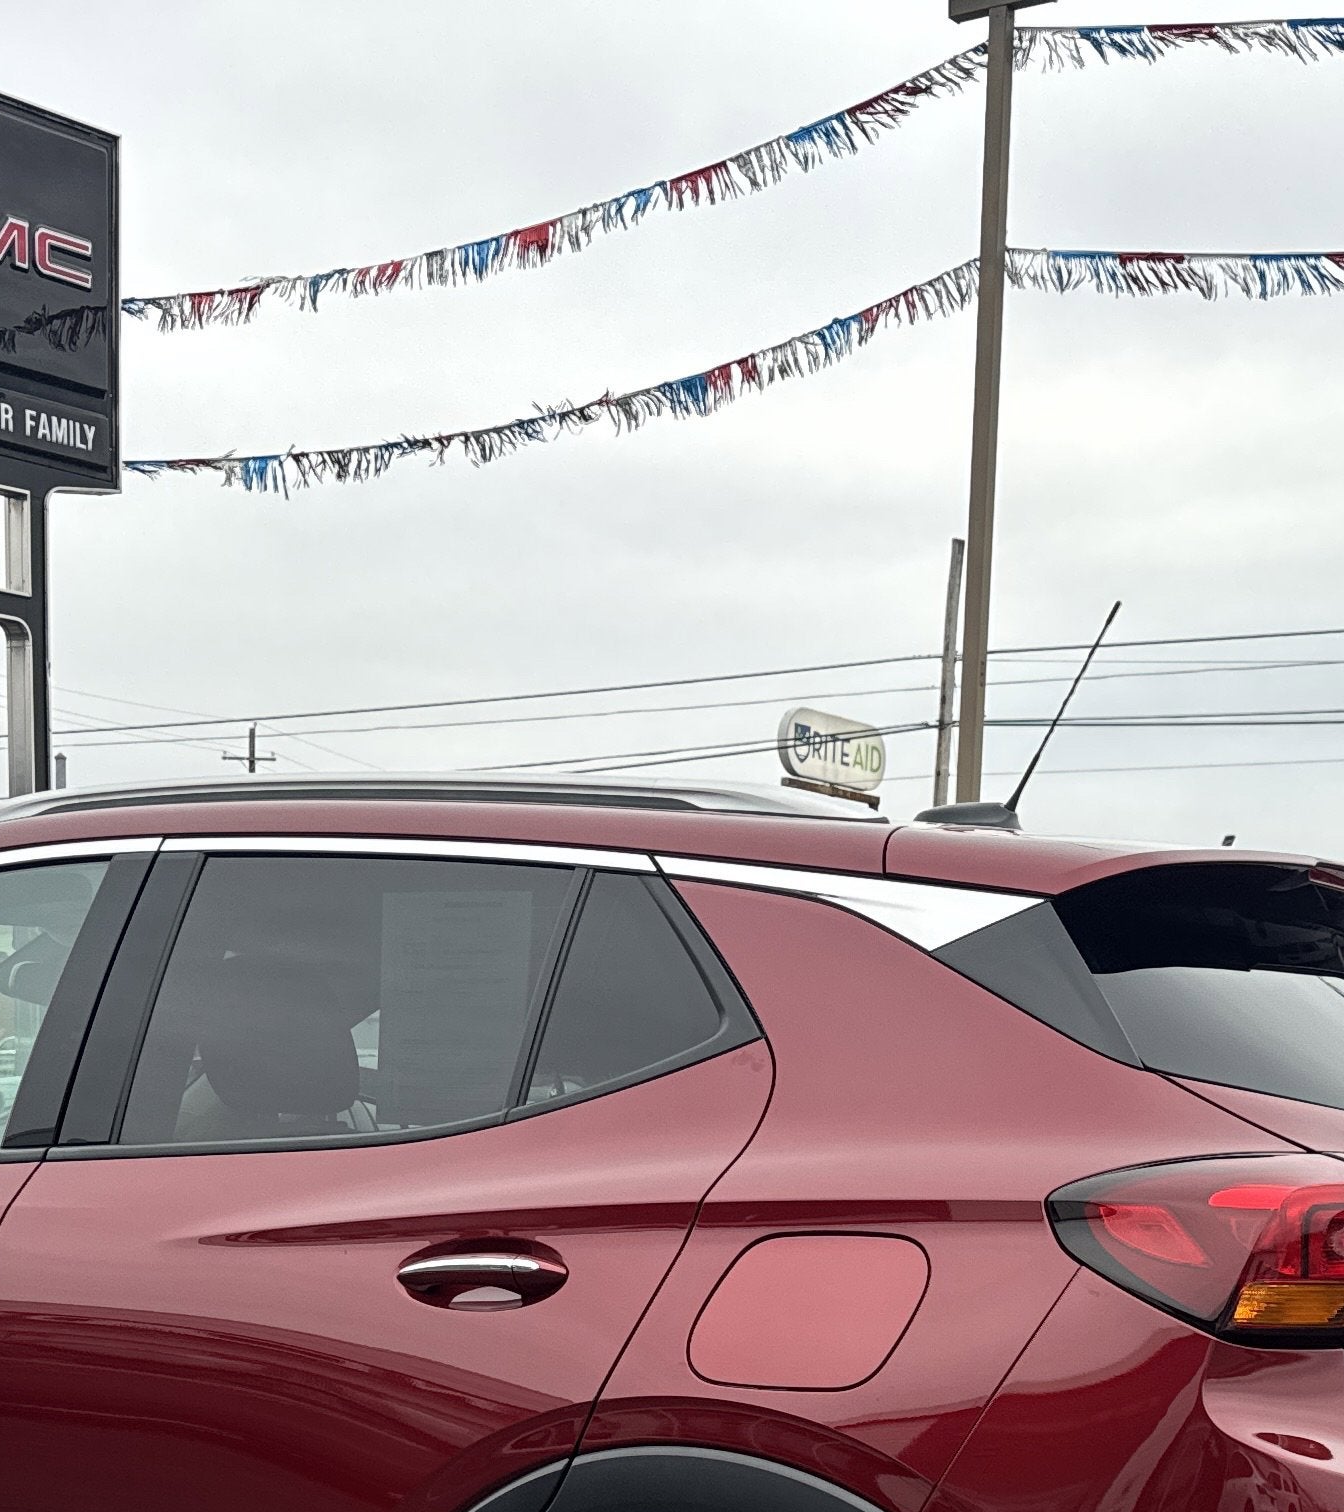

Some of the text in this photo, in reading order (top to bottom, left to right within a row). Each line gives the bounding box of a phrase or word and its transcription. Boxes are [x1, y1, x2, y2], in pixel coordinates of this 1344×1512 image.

[25, 409, 96, 450] FAMILY
[812, 731, 883, 773] RITE AID
